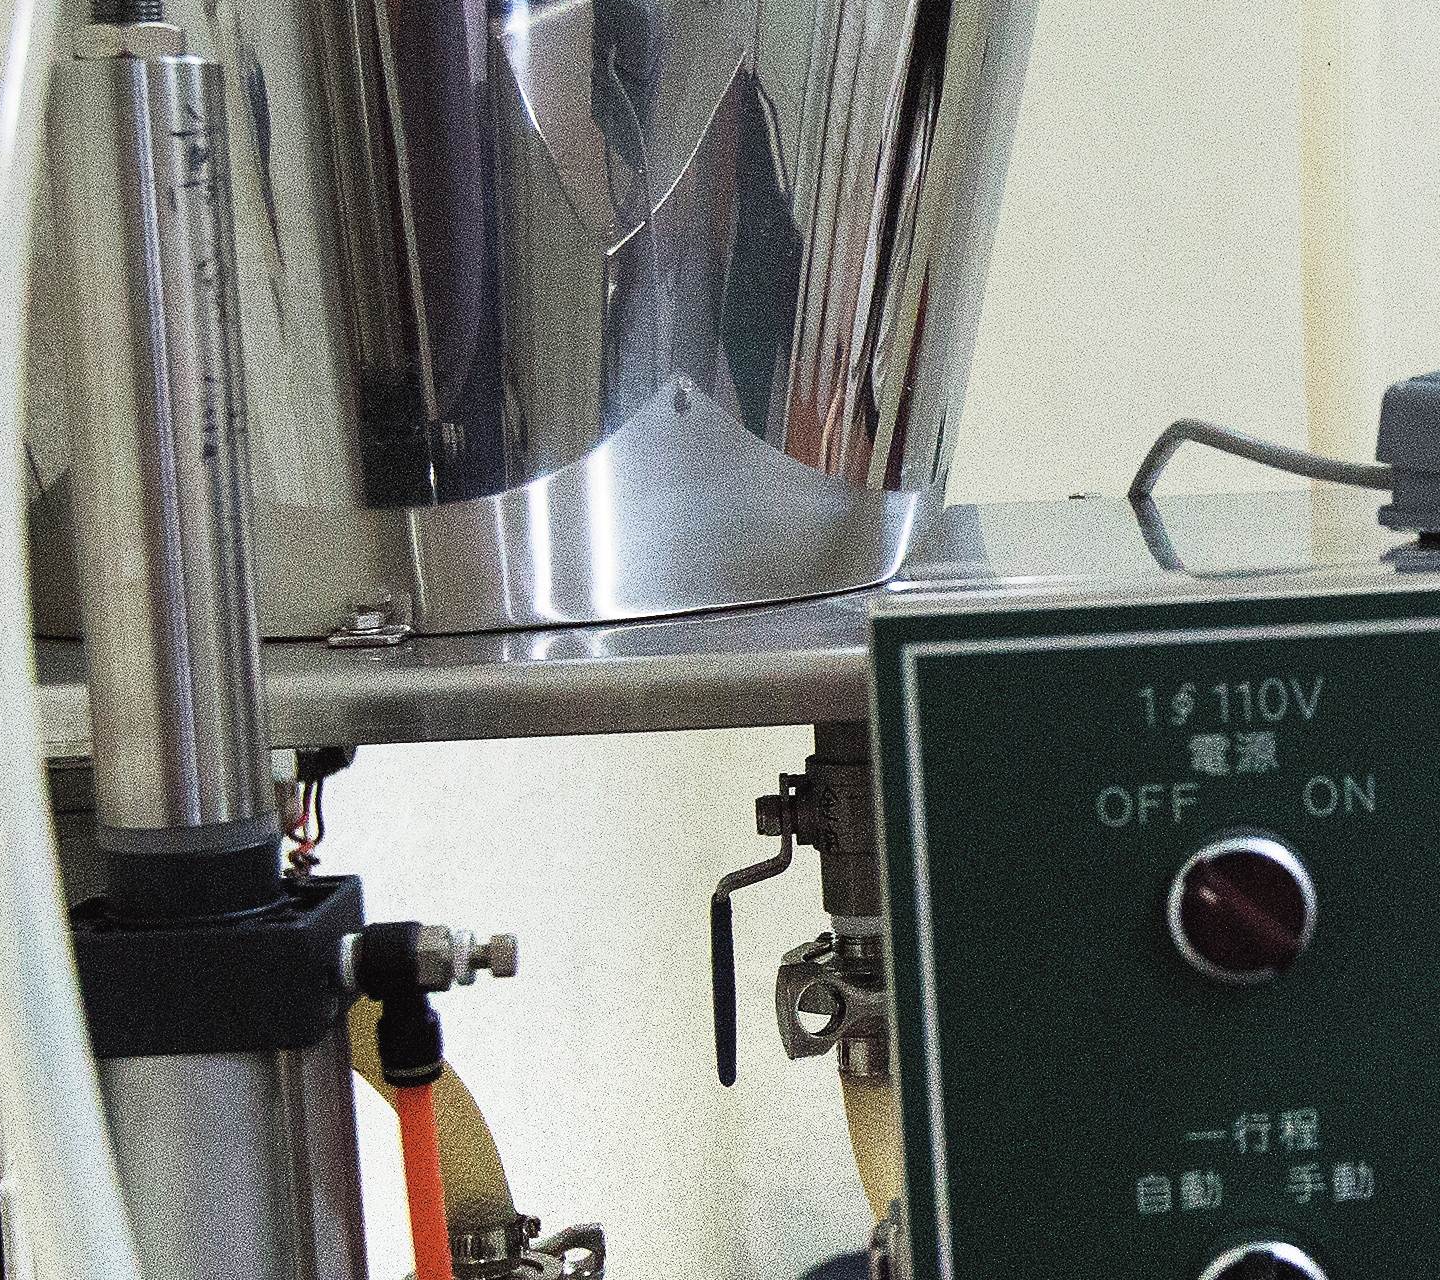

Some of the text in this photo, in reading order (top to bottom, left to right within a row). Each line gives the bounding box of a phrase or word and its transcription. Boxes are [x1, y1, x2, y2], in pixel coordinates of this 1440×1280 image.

[1213, 677, 1324, 722] 110V
[1189, 731, 1278, 775] 電源
[1096, 775, 1376, 828] OFF ON
[1189, 1108, 1319, 1153] 一行程
[1137, 1162, 1373, 1212] 自動 手動
